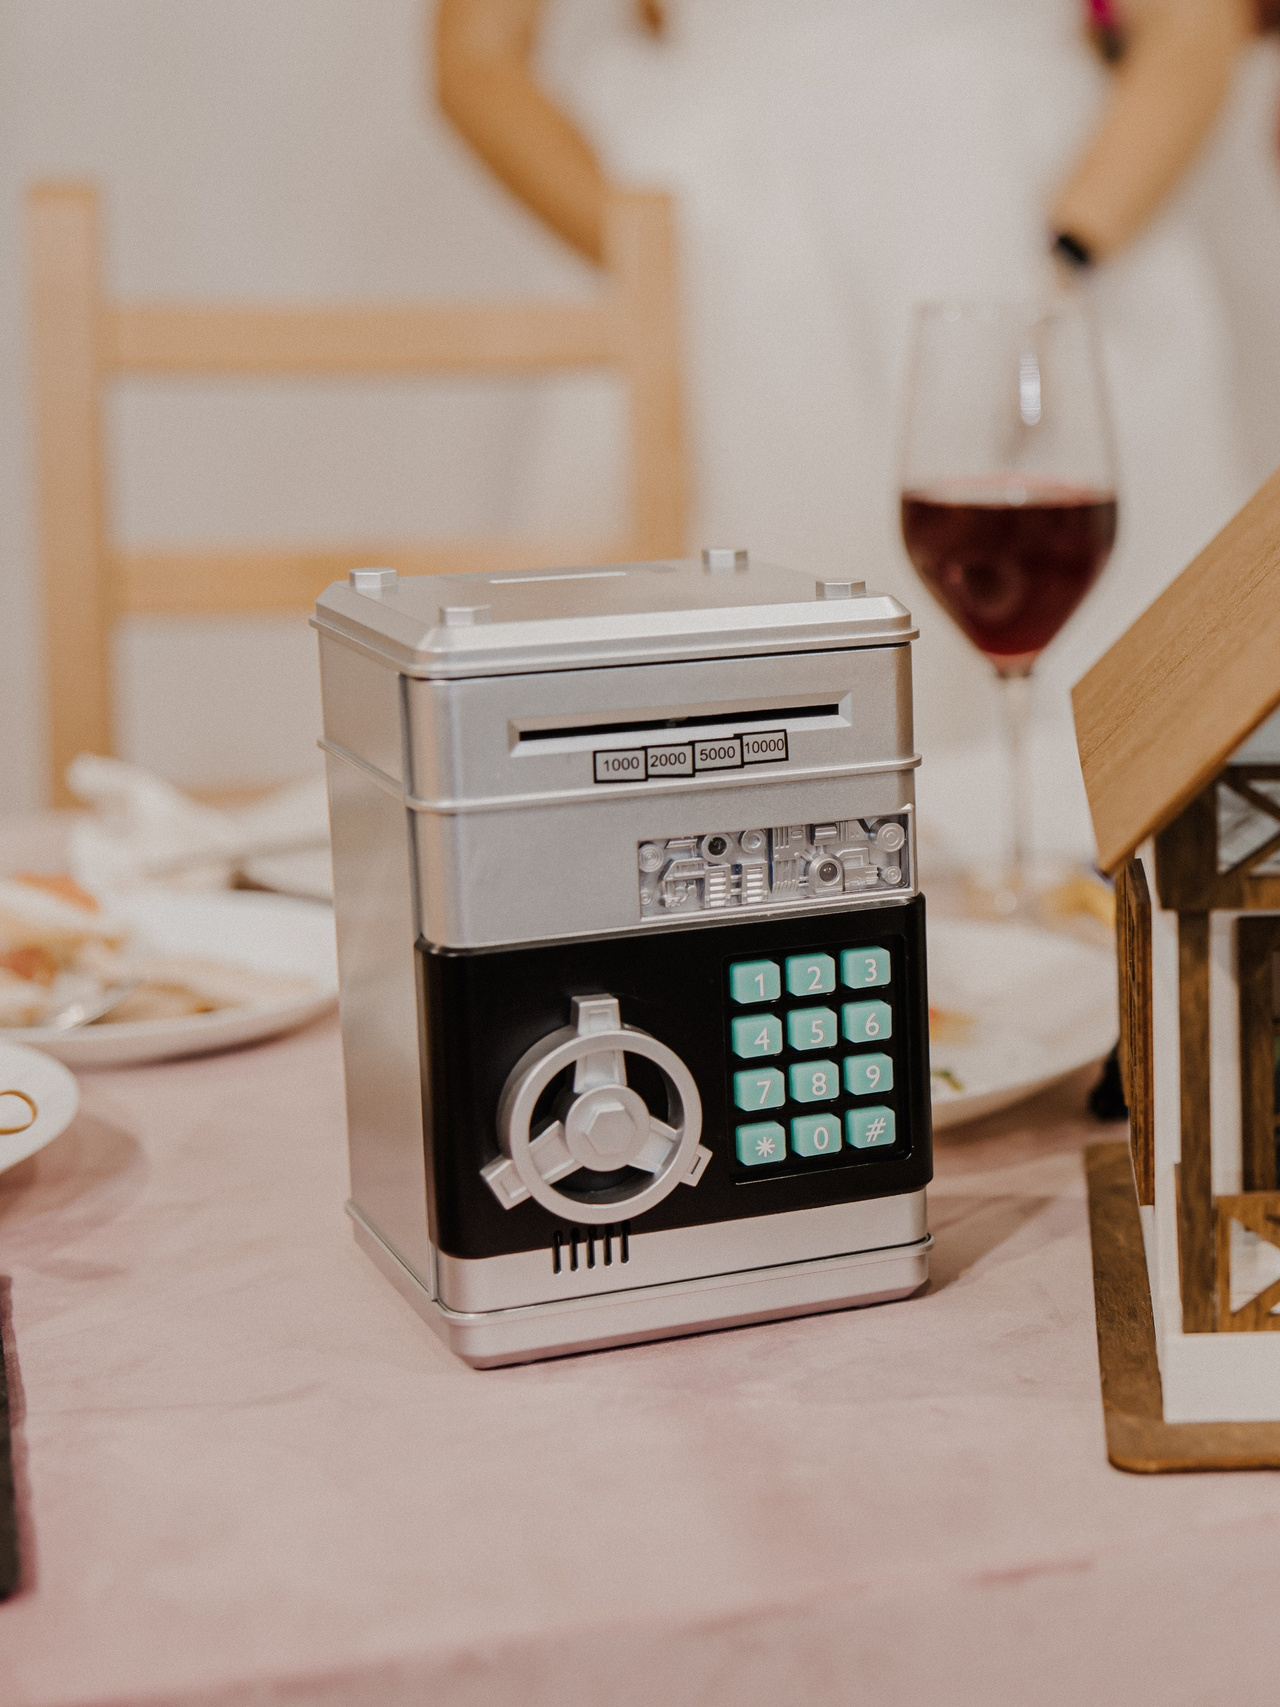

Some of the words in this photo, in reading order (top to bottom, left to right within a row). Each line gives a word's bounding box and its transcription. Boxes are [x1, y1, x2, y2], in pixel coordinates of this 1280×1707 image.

[603, 757, 640, 772] 1000
[650, 751, 687, 768] 2000
[700, 746, 736, 761] 5000
[744, 738, 785, 754] 10000
[754, 973, 765, 997] 1
[807, 966, 823, 990] 2
[864, 958, 877, 982] 3
[754, 1027, 769, 1050] 4
[810, 1020, 824, 1044] 5
[865, 1012, 880, 1036] 6
[756, 1080, 772, 1104] 7
[812, 1072, 827, 1096] 8
[866, 1065, 881, 1088] 9
[813, 1127, 829, 1150] 0
[865, 1117, 886, 1143] #
